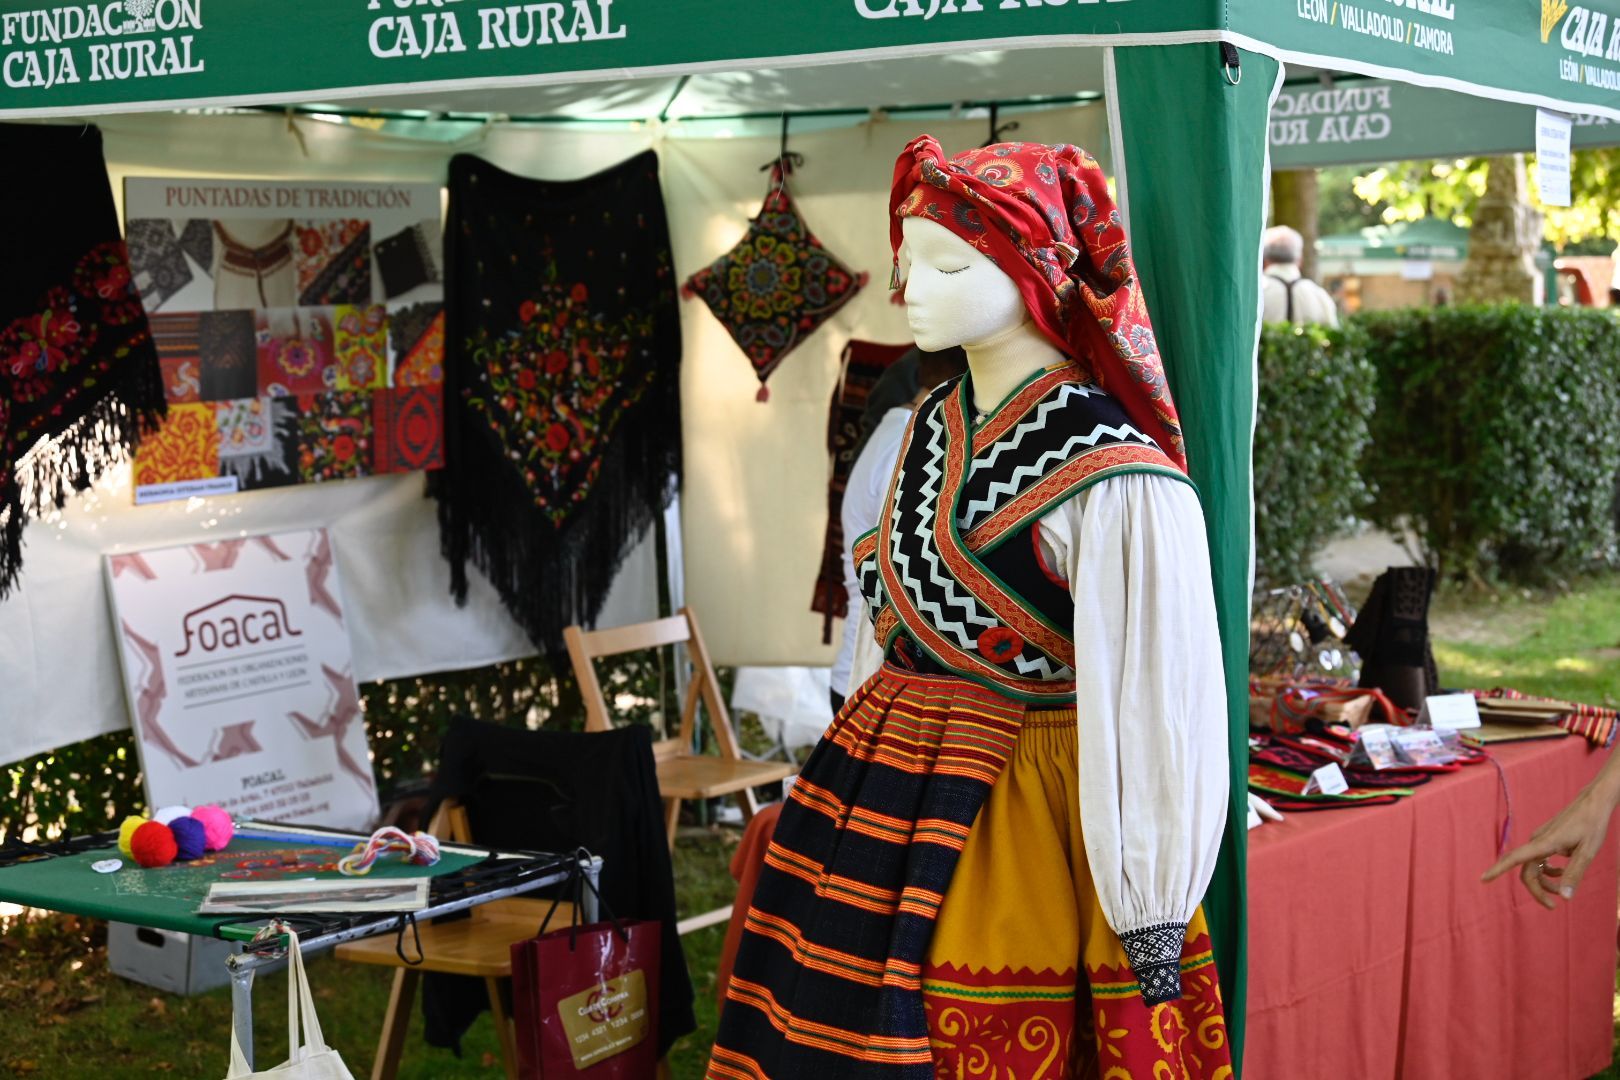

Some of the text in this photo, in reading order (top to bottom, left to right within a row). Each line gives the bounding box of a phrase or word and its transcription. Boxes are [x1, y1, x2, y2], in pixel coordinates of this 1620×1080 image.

[368, 0, 626, 59] CAJA RURAL
[1340, 3, 1404, 43] VALLADOLID
[1413, 24, 1454, 55] ZAMORA
[1561, 6, 1607, 58] CAJA
[3, 35, 205, 89] CAJA RURAL
[165, 184, 411, 208] PUNTADAS DE TRADICIÓN
